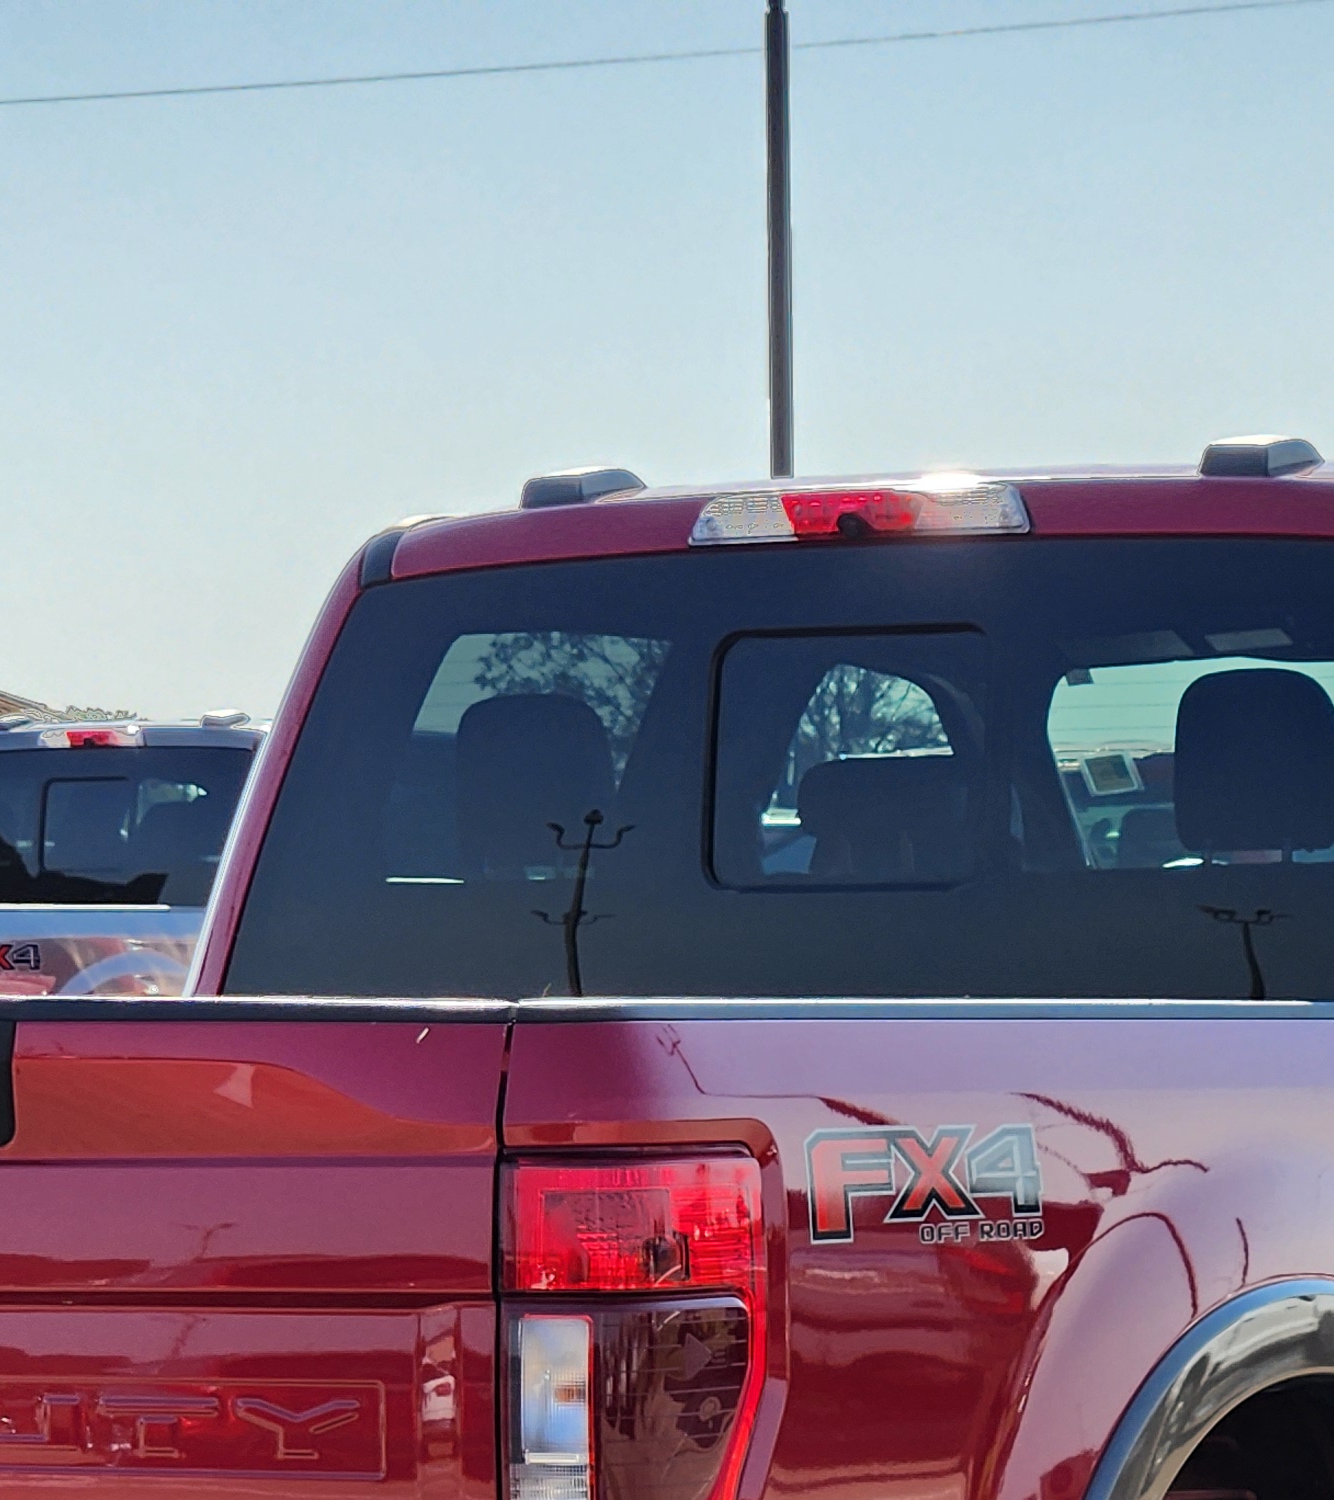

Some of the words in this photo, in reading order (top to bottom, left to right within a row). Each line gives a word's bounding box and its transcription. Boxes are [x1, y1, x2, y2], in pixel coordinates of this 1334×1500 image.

[804, 1123, 1043, 1245] FX4
[920, 1223, 970, 1244] OFF
[978, 1220, 1044, 1240] ROAD
